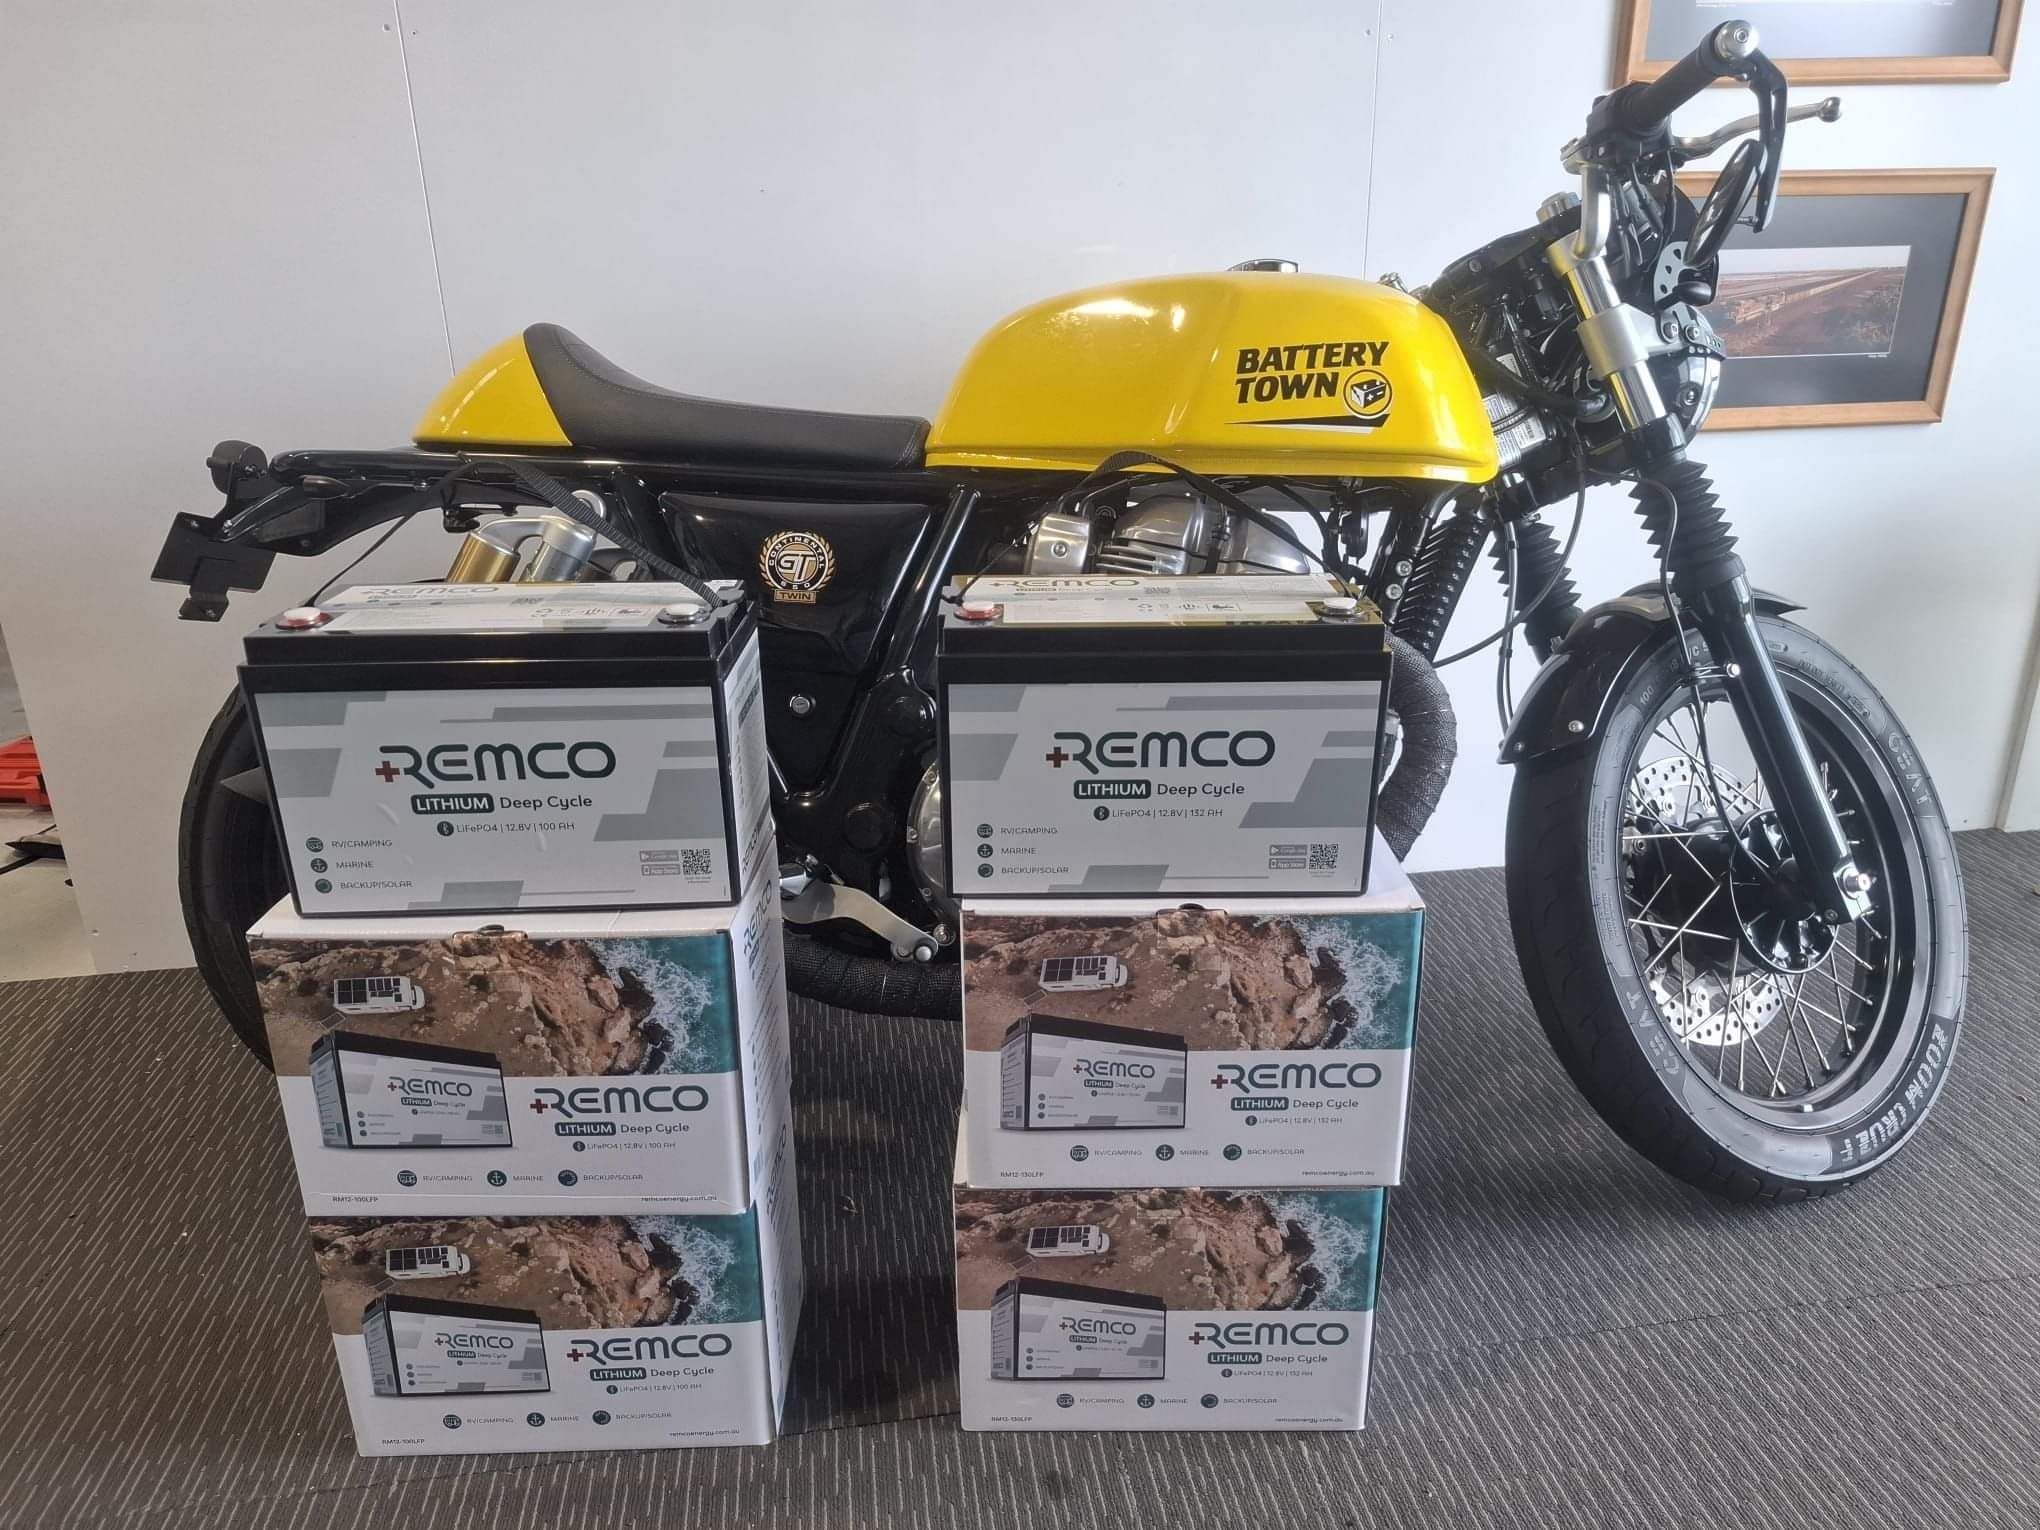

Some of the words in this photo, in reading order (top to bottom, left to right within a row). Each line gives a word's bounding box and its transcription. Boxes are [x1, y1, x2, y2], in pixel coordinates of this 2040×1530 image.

[1236, 341, 1389, 374] BATTERY
[1235, 372, 1339, 403] TOWN
[768, 536, 825, 569] CONTINENTAL
[780, 592, 811, 600] TWIN
[1077, 783, 1147, 796] LITHIUM
[1157, 783, 1198, 798] Deep
[1202, 782, 1245, 798] Cycle
[414, 796, 490, 812] LITHIUM
[500, 797, 543, 811] Deep
[547, 795, 593, 811] Cycle
[1112, 808, 1151, 818] LiFePO4
[1158, 808, 1183, 818] 12.8V
[456, 823, 498, 834] LiFePO4
[505, 823, 532, 833] 12.8V
[1000, 847, 1037, 855] MARINE
[336, 861, 374, 870] MARINE
[1904, 1023, 1949, 1110] ZOOM
[1233, 1099, 1286, 1109] LITHIUM
[1293, 1099, 1324, 1110] Deep
[1326, 1098, 1359, 1110] Cycle
[557, 1124, 614, 1134] LITHIUM
[620, 1123, 653, 1135] Deep
[655, 1122, 690, 1135] Cycle
[1210, 1353, 1260, 1363] LITHIUM
[1265, 1353, 1296, 1364] Deep
[1297, 1353, 1329, 1364] Cycle
[592, 1369, 644, 1380] LITHIUM
[650, 1368, 681, 1378] Deep
[683, 1366, 715, 1377] Cycle
